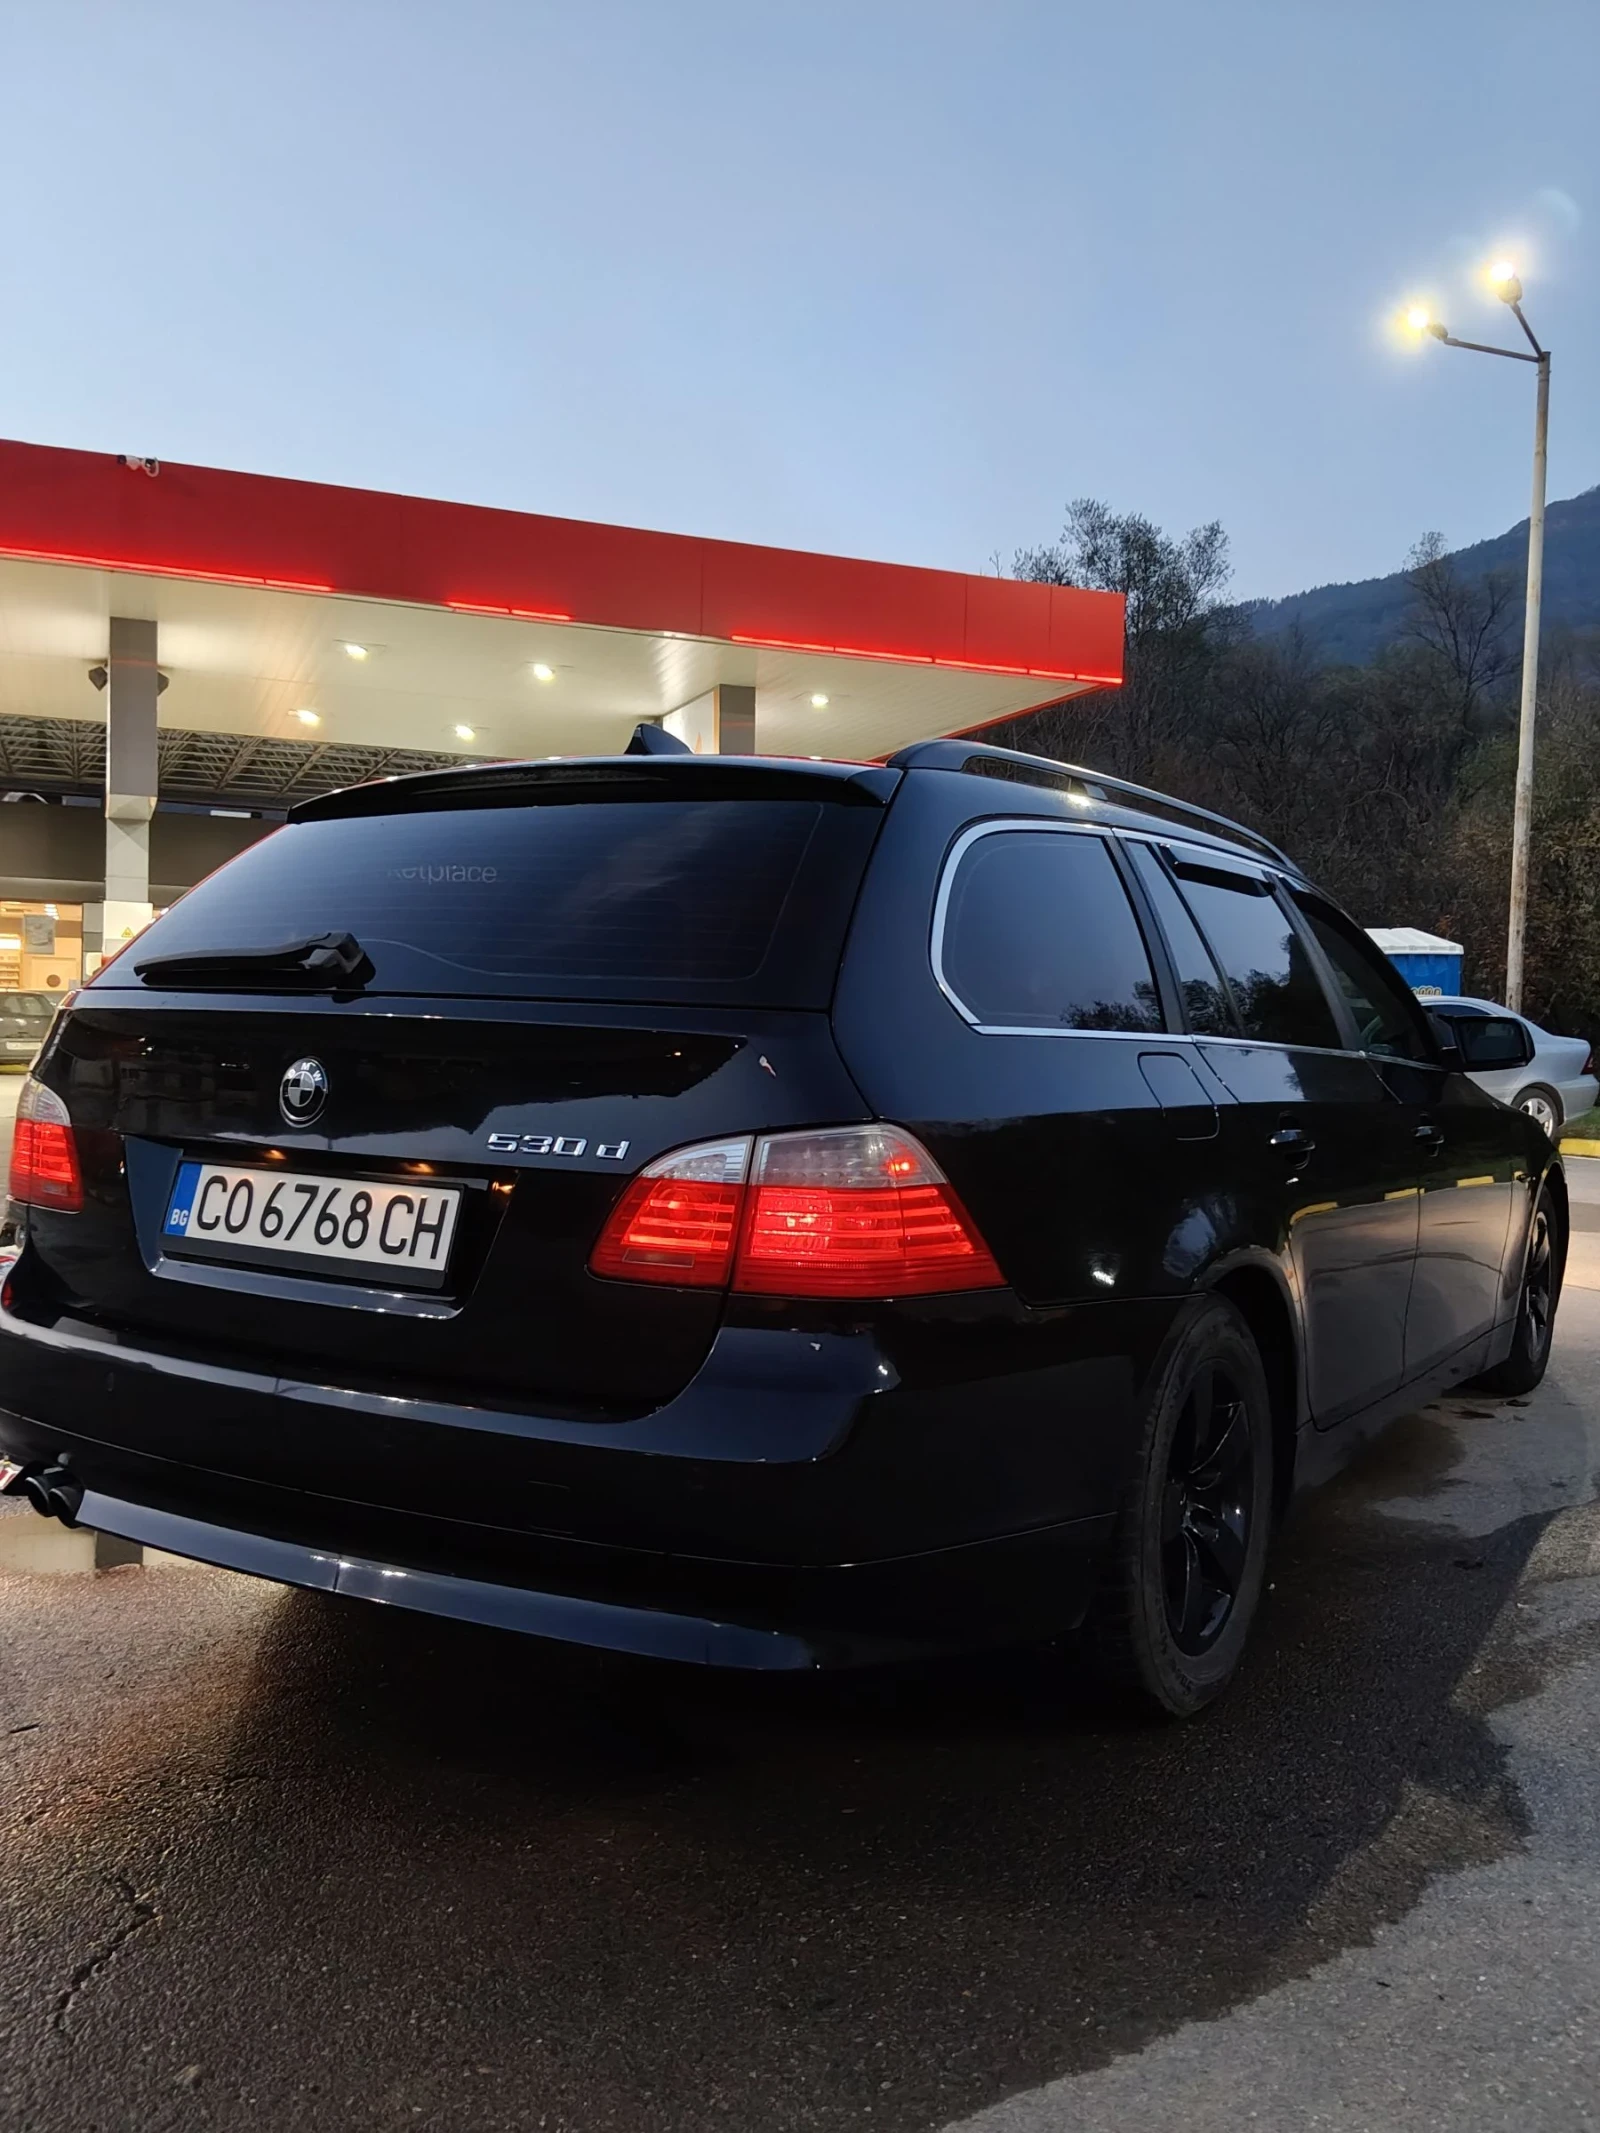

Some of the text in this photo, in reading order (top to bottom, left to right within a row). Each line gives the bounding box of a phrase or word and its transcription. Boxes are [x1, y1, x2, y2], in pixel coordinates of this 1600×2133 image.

[287, 1061, 322, 1081] BMW
[486, 1132, 630, 1159] 530 d
[170, 1208, 190, 1226] BG
[197, 1175, 449, 1260] CO 6768 CH
